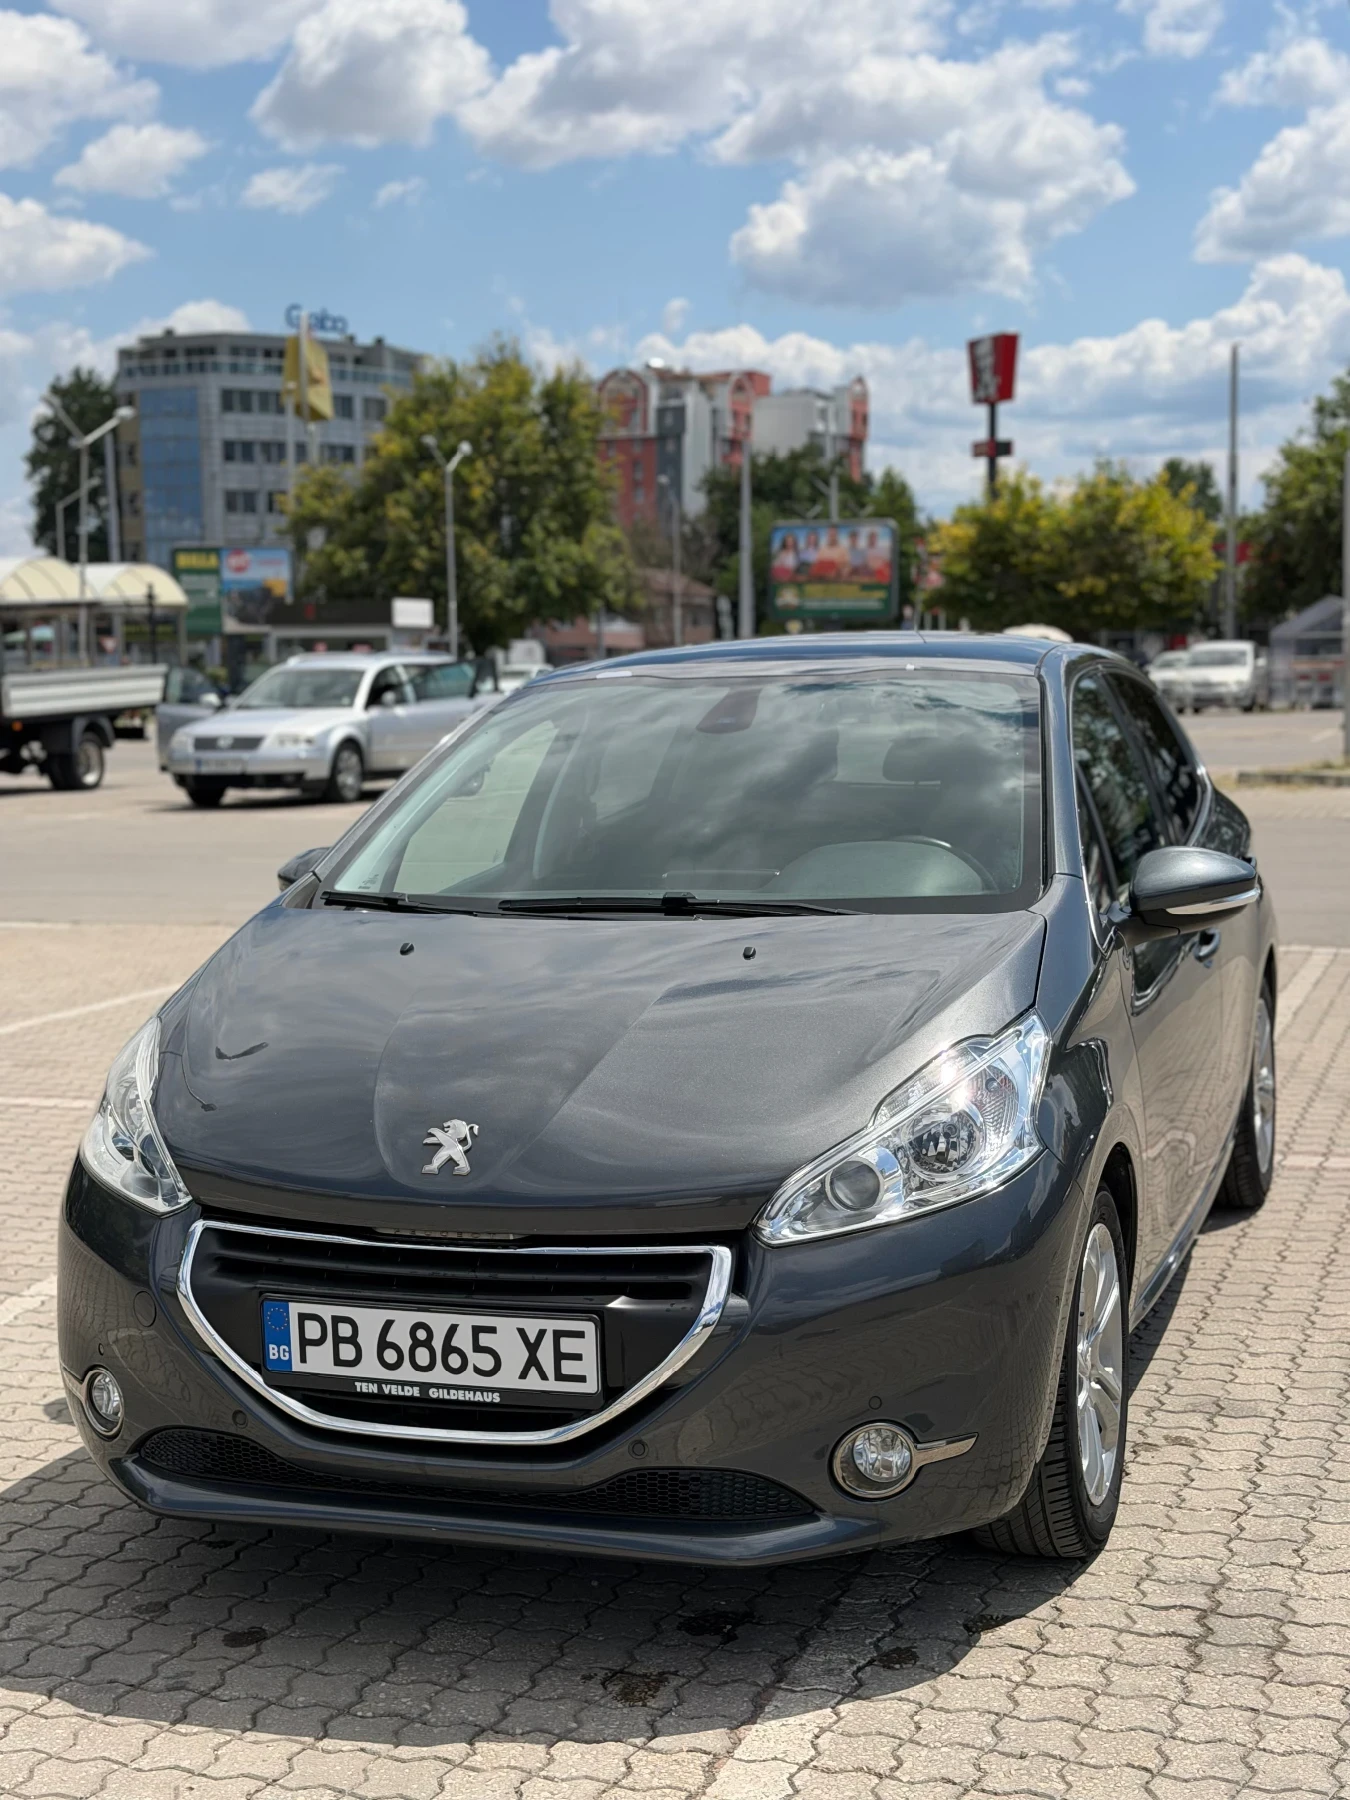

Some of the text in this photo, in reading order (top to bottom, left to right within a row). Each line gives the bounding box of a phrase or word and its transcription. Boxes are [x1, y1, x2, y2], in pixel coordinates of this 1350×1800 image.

[268, 1343, 290, 1361] BG
[297, 1312, 588, 1383] PB 6865 XE
[355, 1381, 501, 1403] TEN VELDE GILDEHAUS
